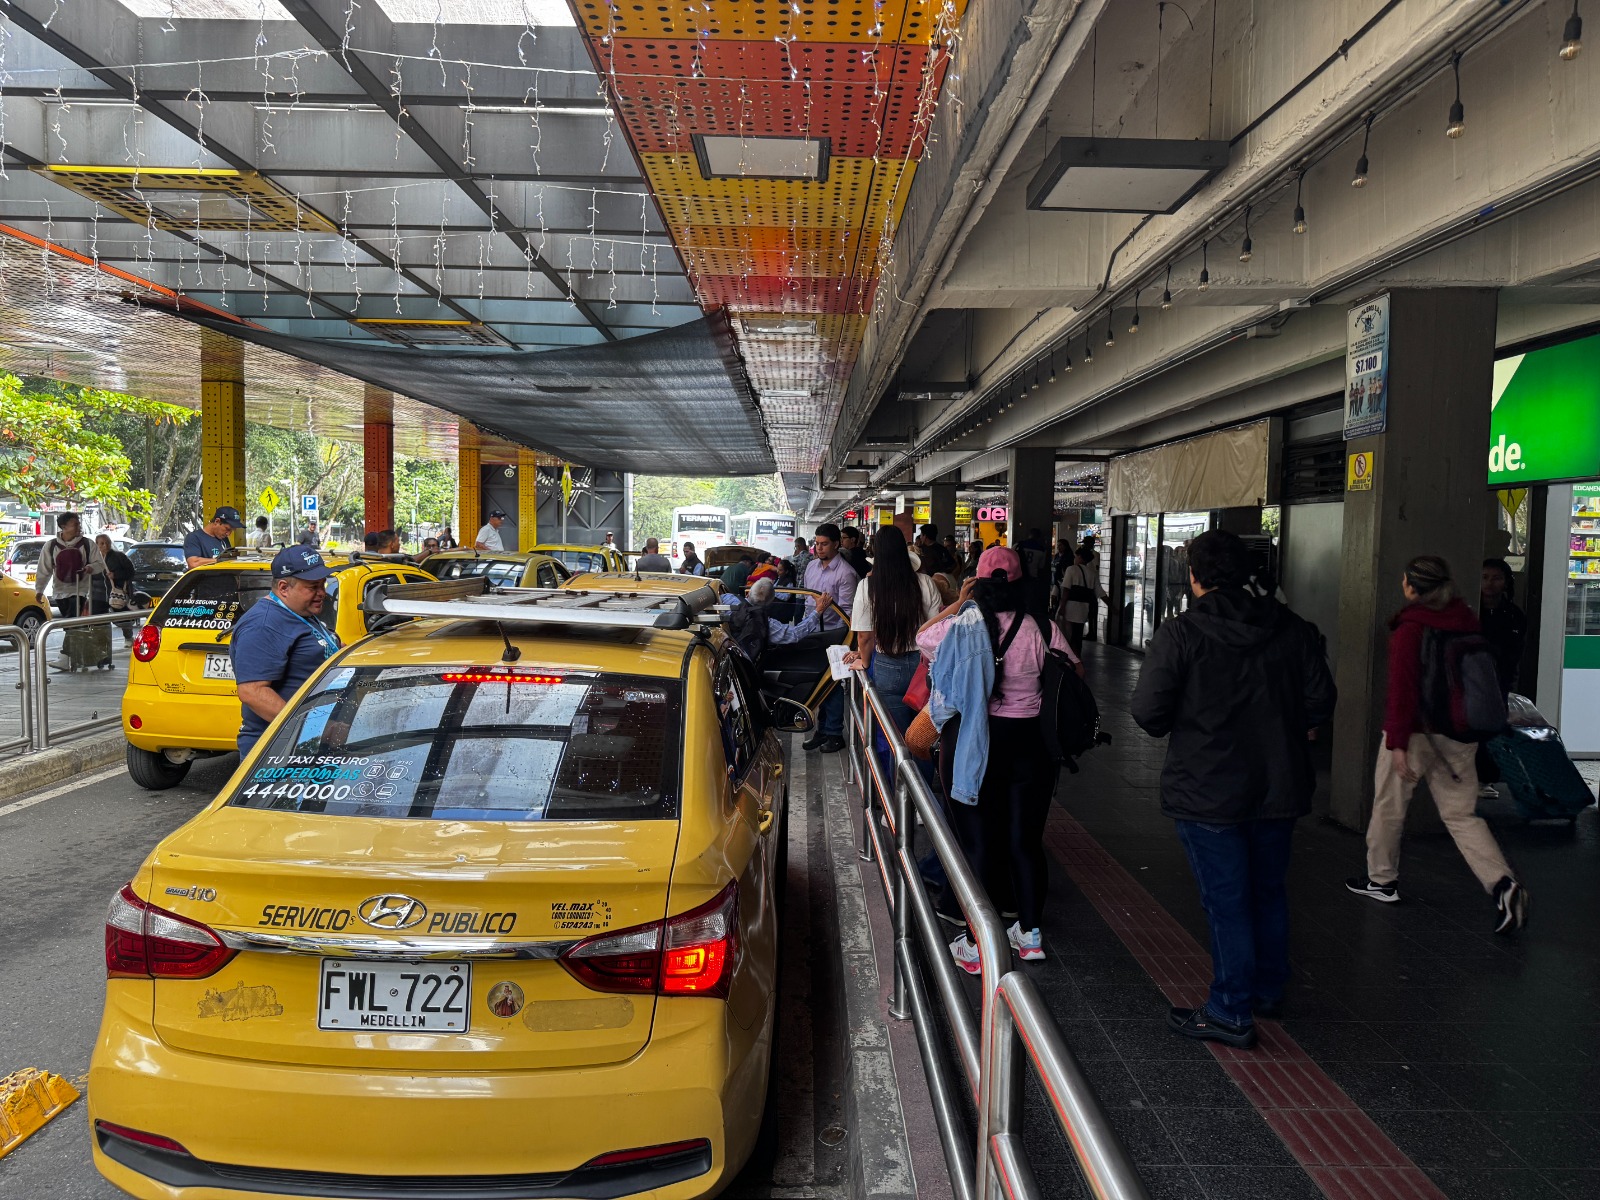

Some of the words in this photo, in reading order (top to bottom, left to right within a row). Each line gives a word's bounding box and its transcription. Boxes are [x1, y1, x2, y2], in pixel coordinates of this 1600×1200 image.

[306, 497, 314, 509] P
[758, 520, 794, 528] TERMINAL
[164, 618, 183, 627] 604
[207, 658, 228, 672] TSI
[267, 756, 284, 765] TU
[286, 756, 314, 765] TAXI
[315, 756, 370, 766] SEGURO
[242, 783, 351, 801] 4440000
[188, 885, 217, 902] i10
[258, 904, 350, 931] SERVICIO
[427, 912, 517, 934] PUBLICO
[324, 971, 388, 1012] FWL
[400, 973, 464, 1013] 722
[360, 1014, 426, 1027] MEDELLIN
